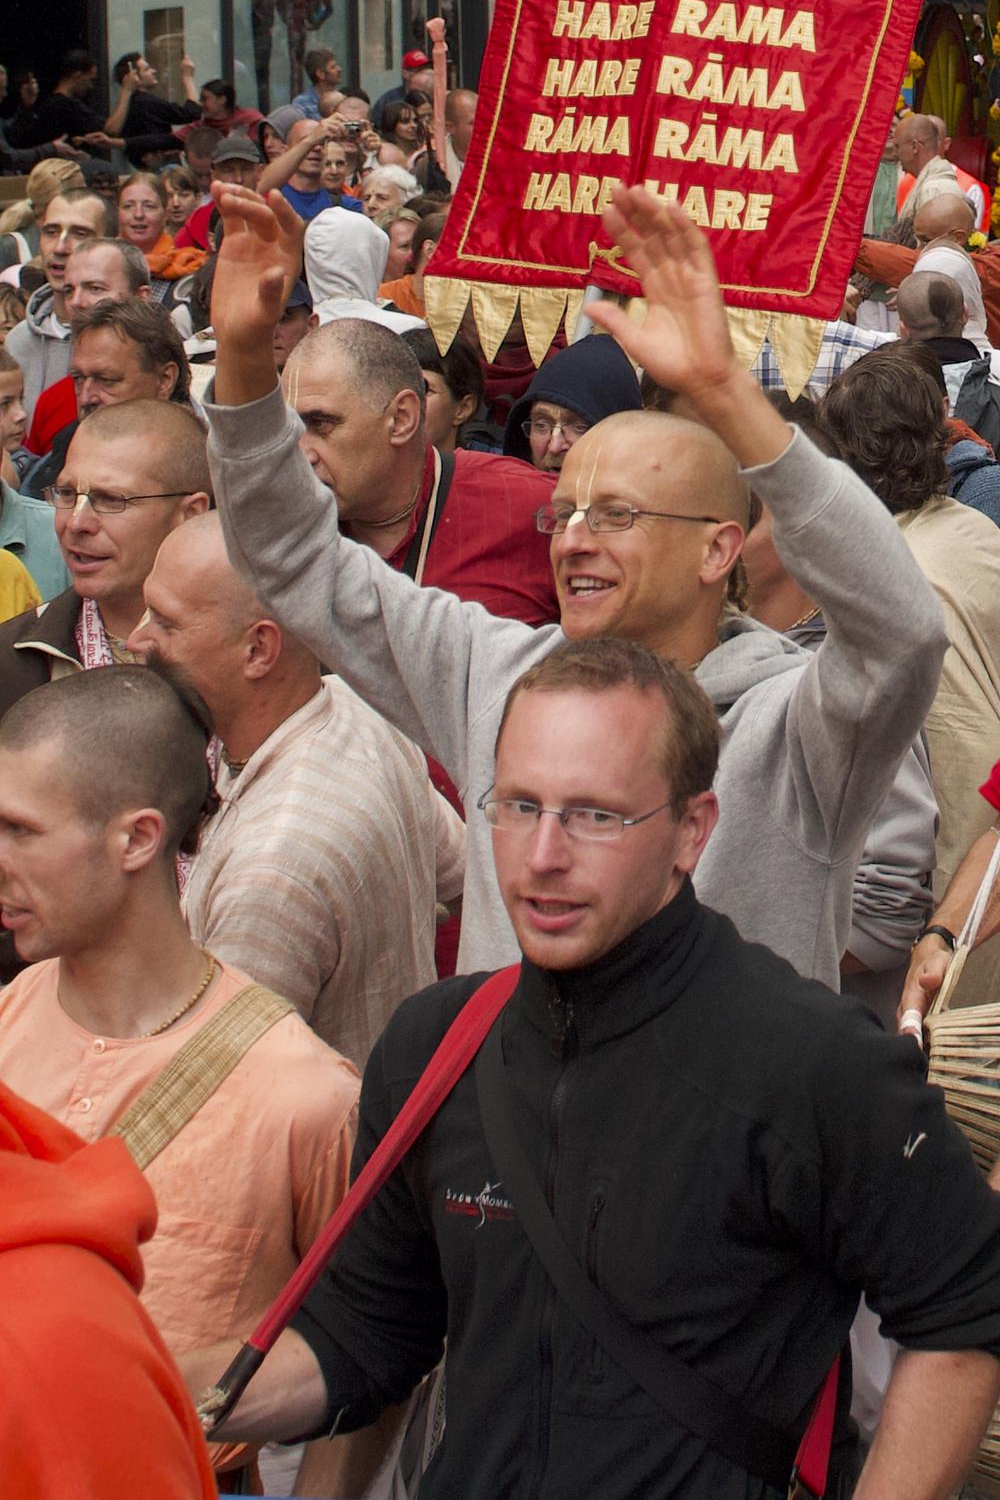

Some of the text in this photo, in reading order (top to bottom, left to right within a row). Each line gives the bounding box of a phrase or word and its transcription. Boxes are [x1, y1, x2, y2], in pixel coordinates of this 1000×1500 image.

[552, 0, 656, 41] HARE
[541, 58, 642, 98] HARE
[522, 172, 622, 215] HARE
